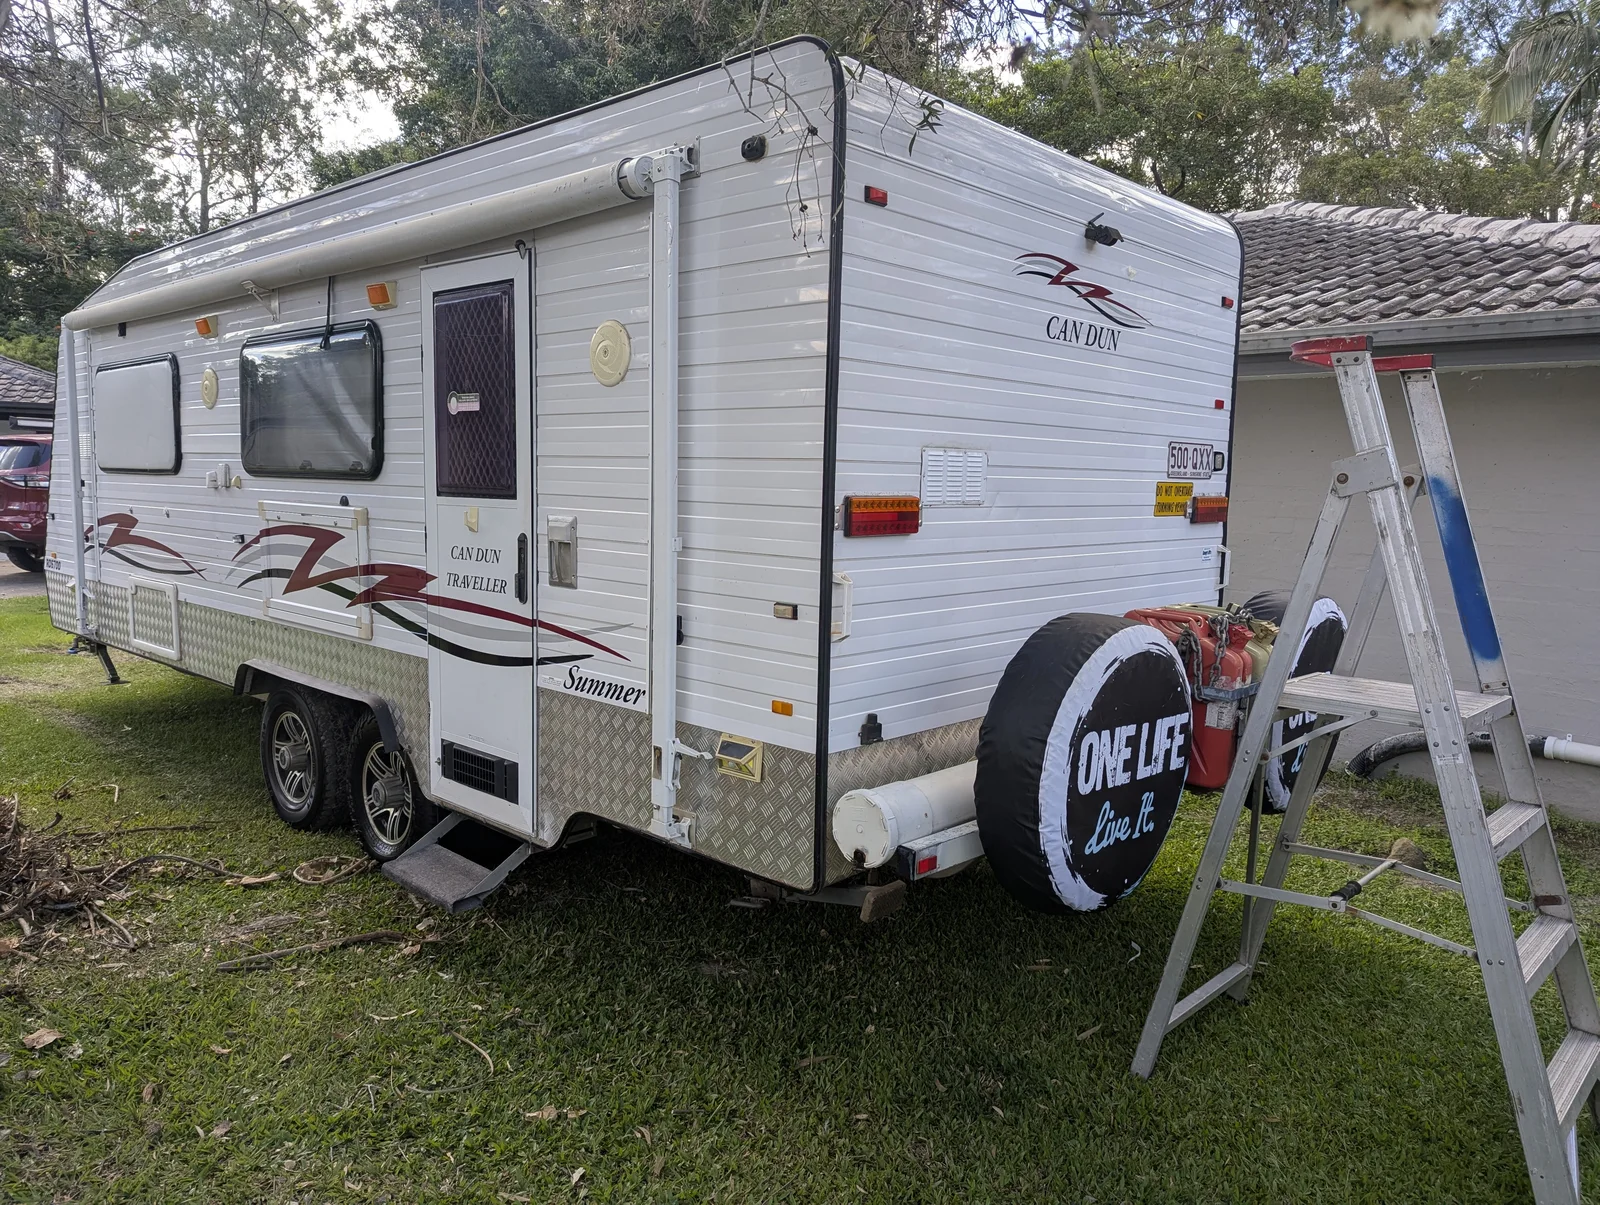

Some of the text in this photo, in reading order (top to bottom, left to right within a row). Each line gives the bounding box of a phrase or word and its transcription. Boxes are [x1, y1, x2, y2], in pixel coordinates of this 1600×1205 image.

[1046, 315, 1121, 351] CAN DUN
[1157, 485, 1193, 497] DO NOT OVERTAKE
[450, 545, 502, 564] CAN DUN
[446, 572, 508, 595] TRAVELLER
[563, 664, 646, 705] Summer
[1077, 712, 1189, 796] ONE LIFE
[1084, 800, 1131, 855] Live
